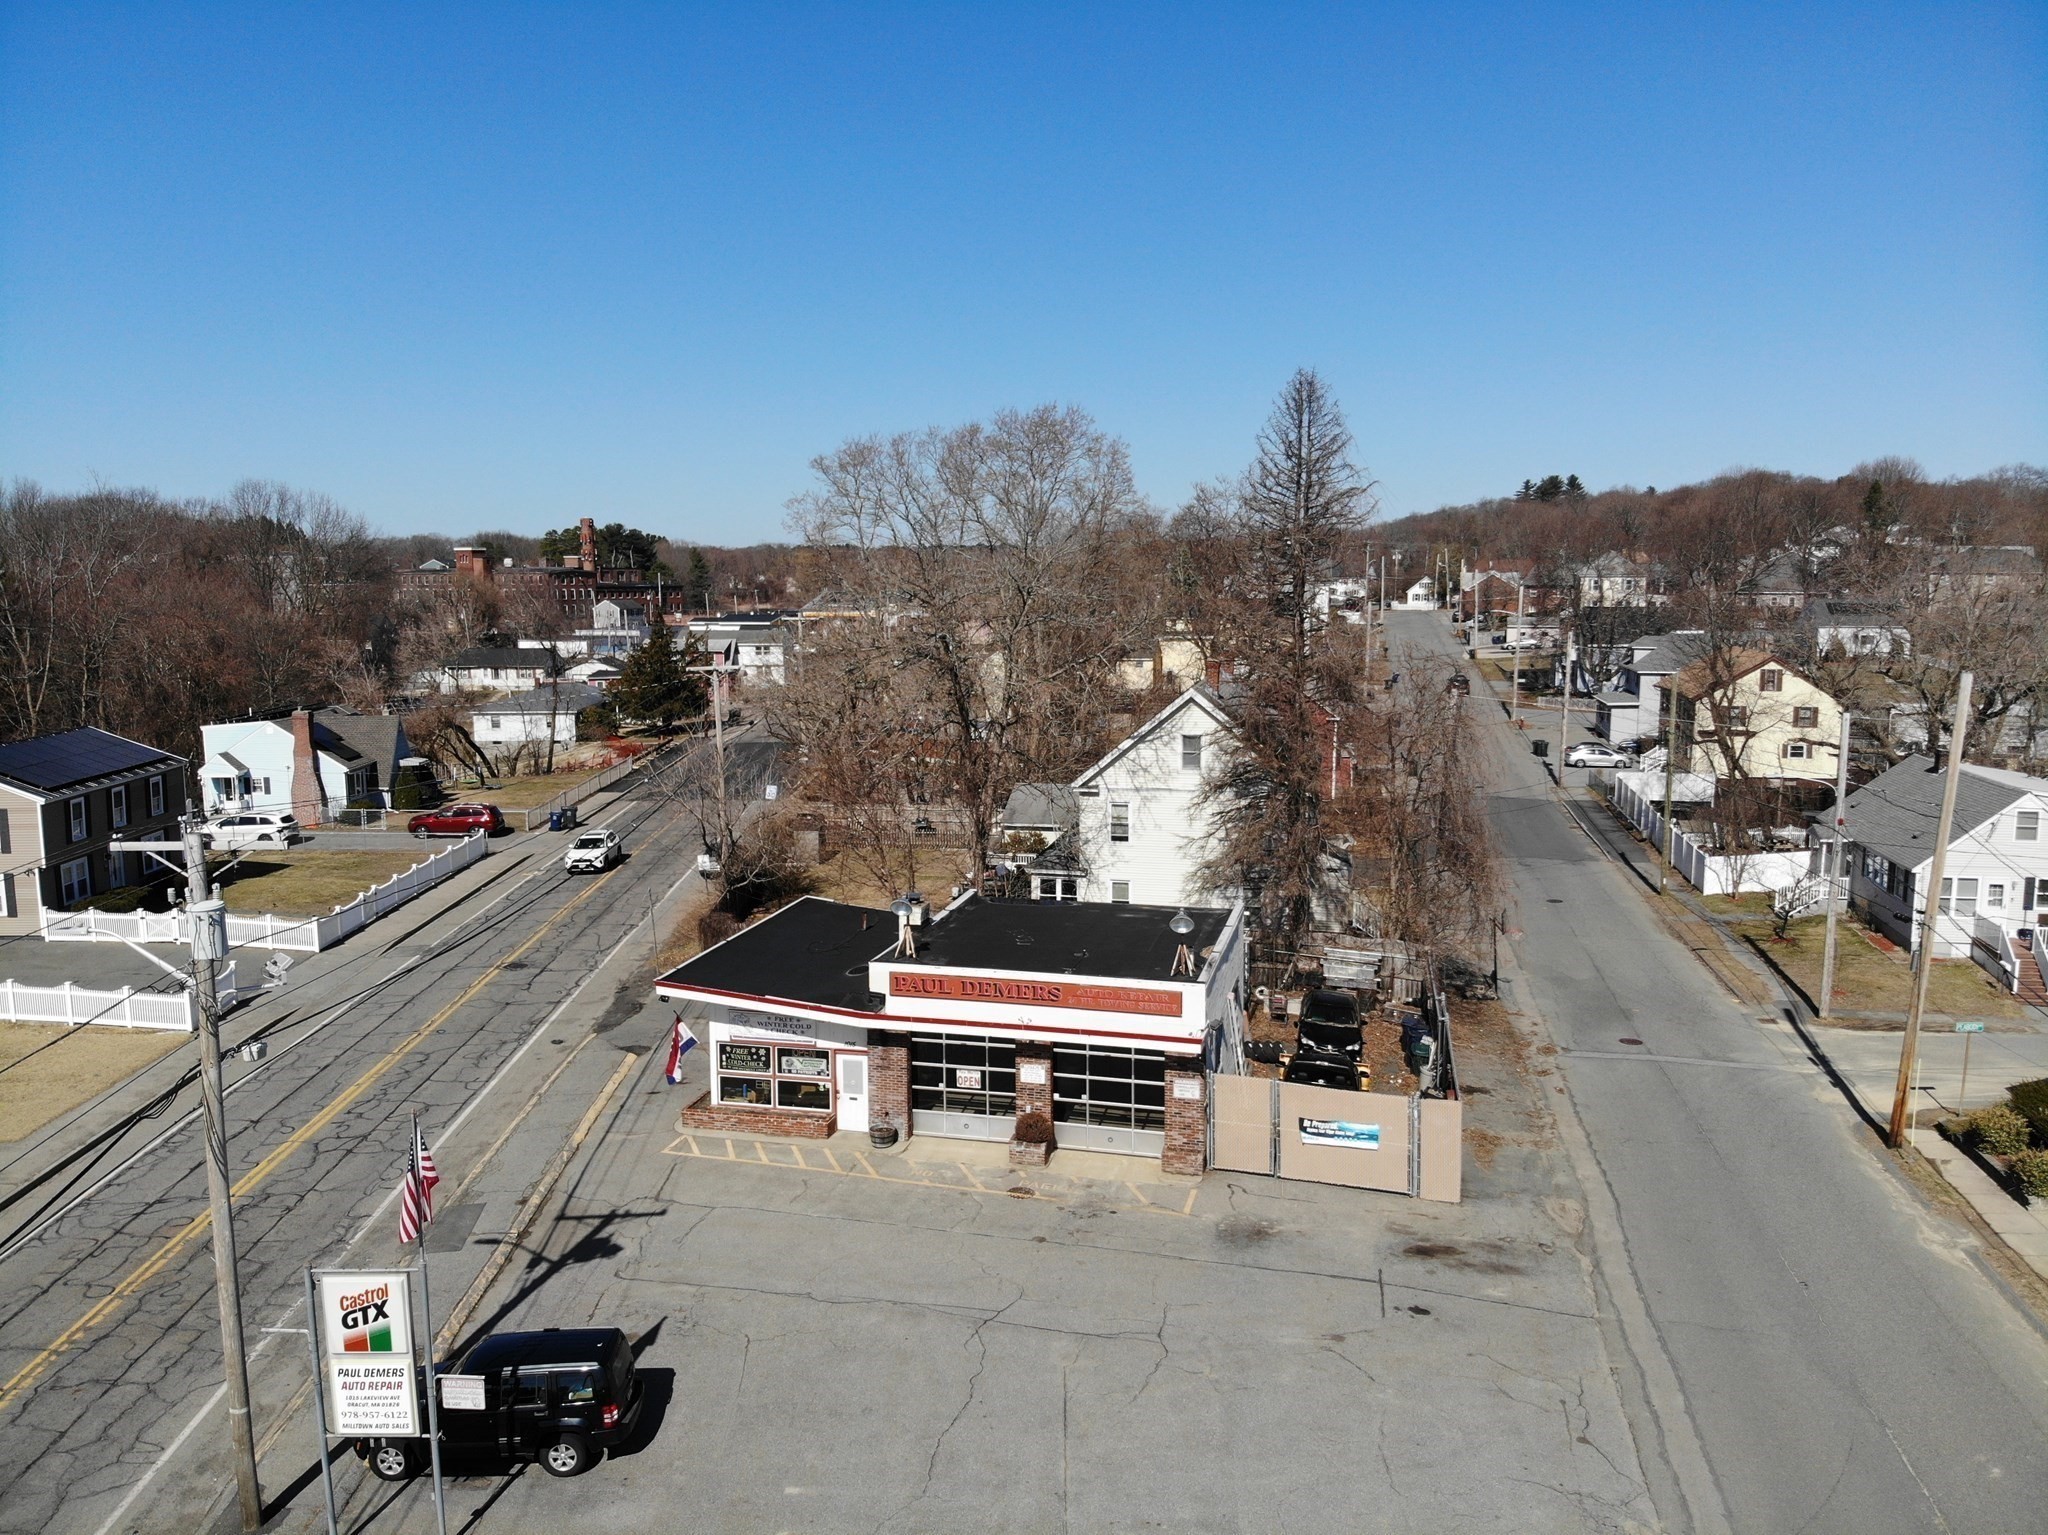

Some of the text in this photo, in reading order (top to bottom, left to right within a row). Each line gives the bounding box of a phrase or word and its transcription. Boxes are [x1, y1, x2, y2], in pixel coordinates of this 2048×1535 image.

[894, 976, 1062, 1002] PAUL DEMERS
[1077, 988, 1169, 1002] AUTO REPAIR
[1099, 998, 1136, 1009] TOWING
[1138, 1001, 1178, 1012] SERVICE
[774, 1015, 795, 1023] FREE
[757, 1021, 812, 1030] WINTER COLD
[730, 1053, 752, 1061] WINTER
[791, 1050, 817, 1058] OPEN
[957, 1075, 980, 1087] OPEN
[911, 1169, 934, 1177] NO
[340, 1283, 389, 1311] Castrol
[341, 1299, 390, 1329] GTX
[337, 1368, 405, 1378] PAUL DEMERS
[341, 1381, 403, 1391] AUTO REPAIR
[443, 1380, 482, 1388] WARNING
[341, 1411, 408, 1419] 978-957-6122
